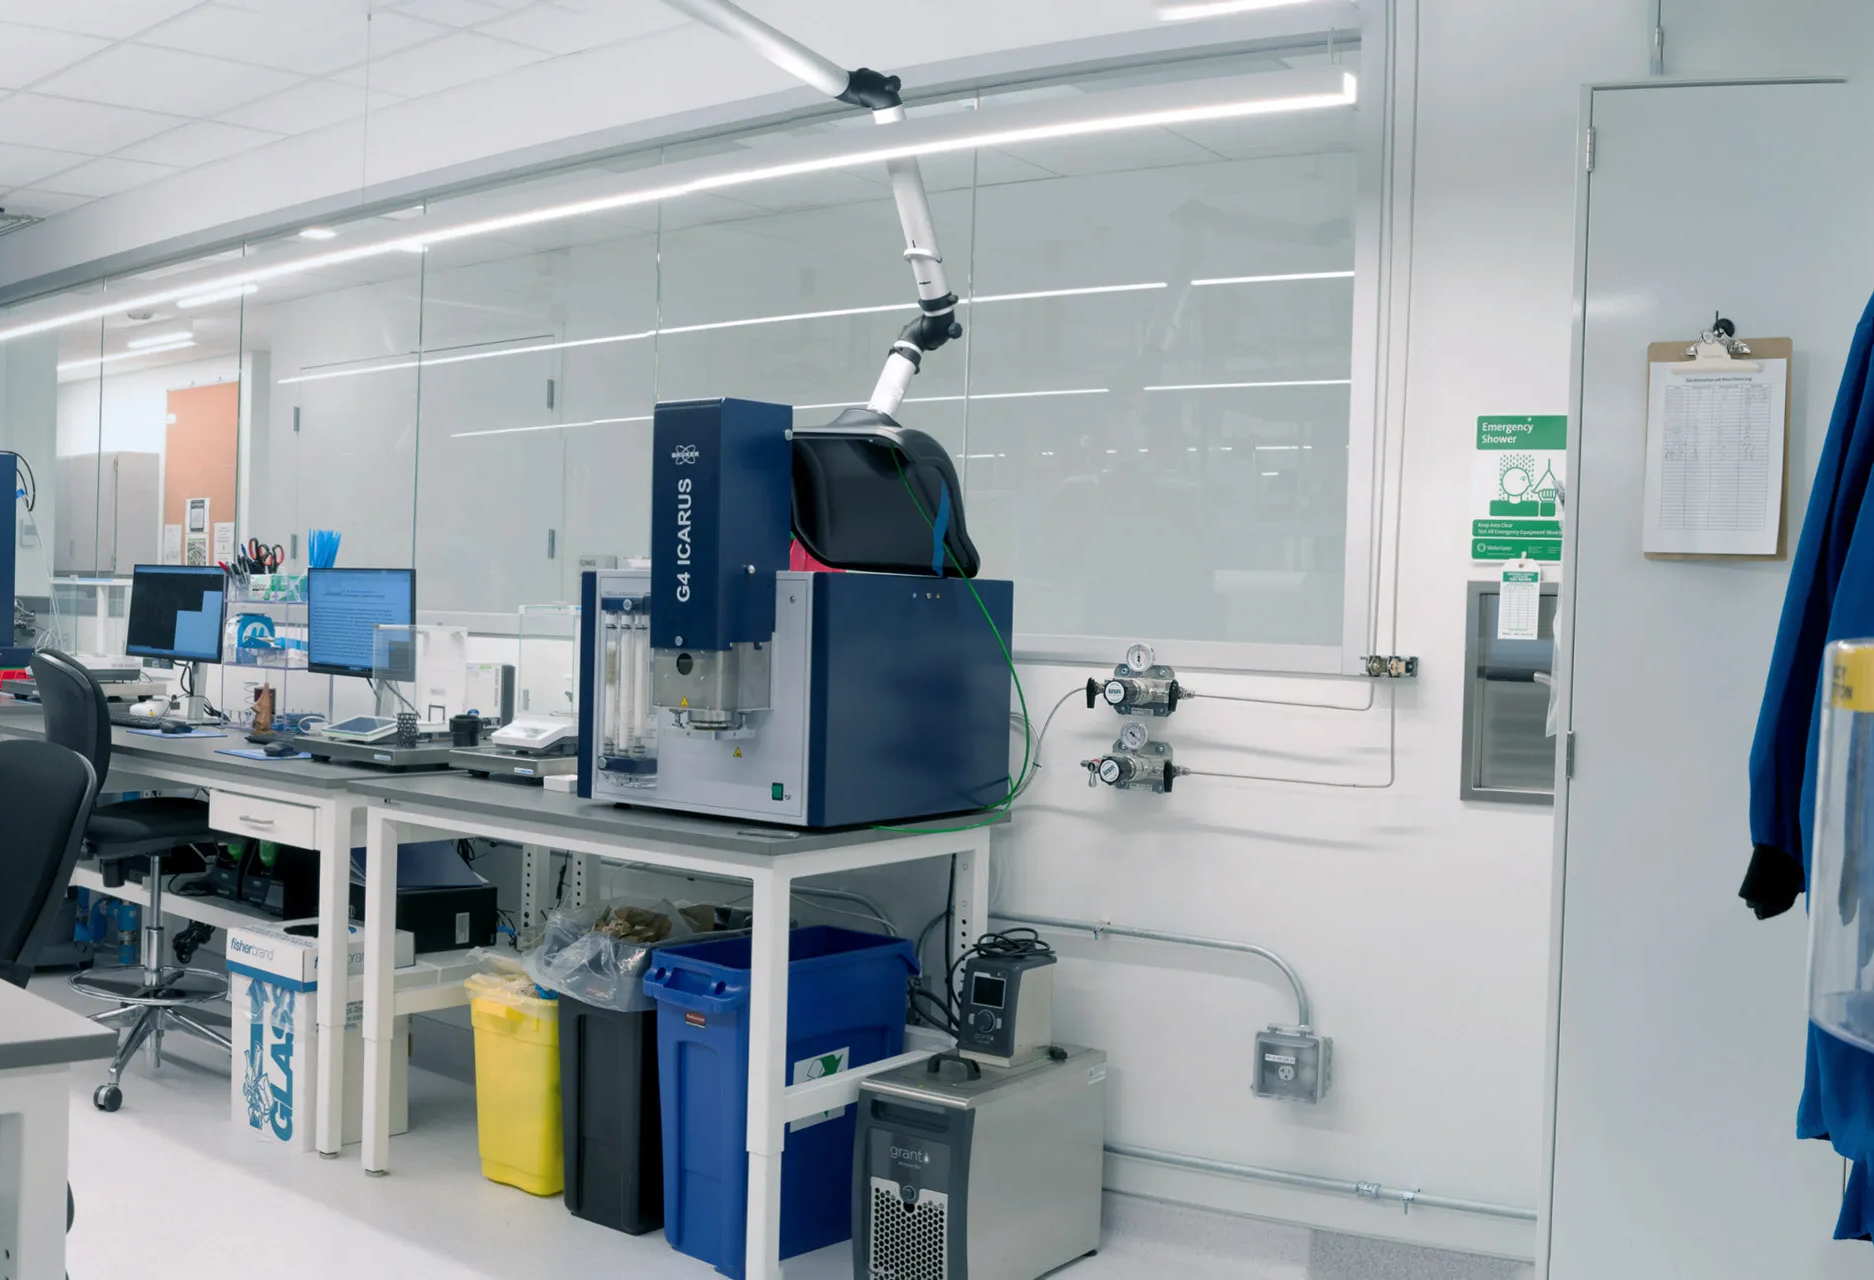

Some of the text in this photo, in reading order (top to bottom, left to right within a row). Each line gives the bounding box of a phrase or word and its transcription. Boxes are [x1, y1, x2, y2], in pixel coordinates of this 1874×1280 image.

[1482, 422, 1533, 434] Emergency
[1482, 434, 1517, 444] Shower
[677, 478, 692, 602] G4 ICARUS
[231, 938, 275, 960] fisherbrand
[889, 1146, 923, 1163] grant
